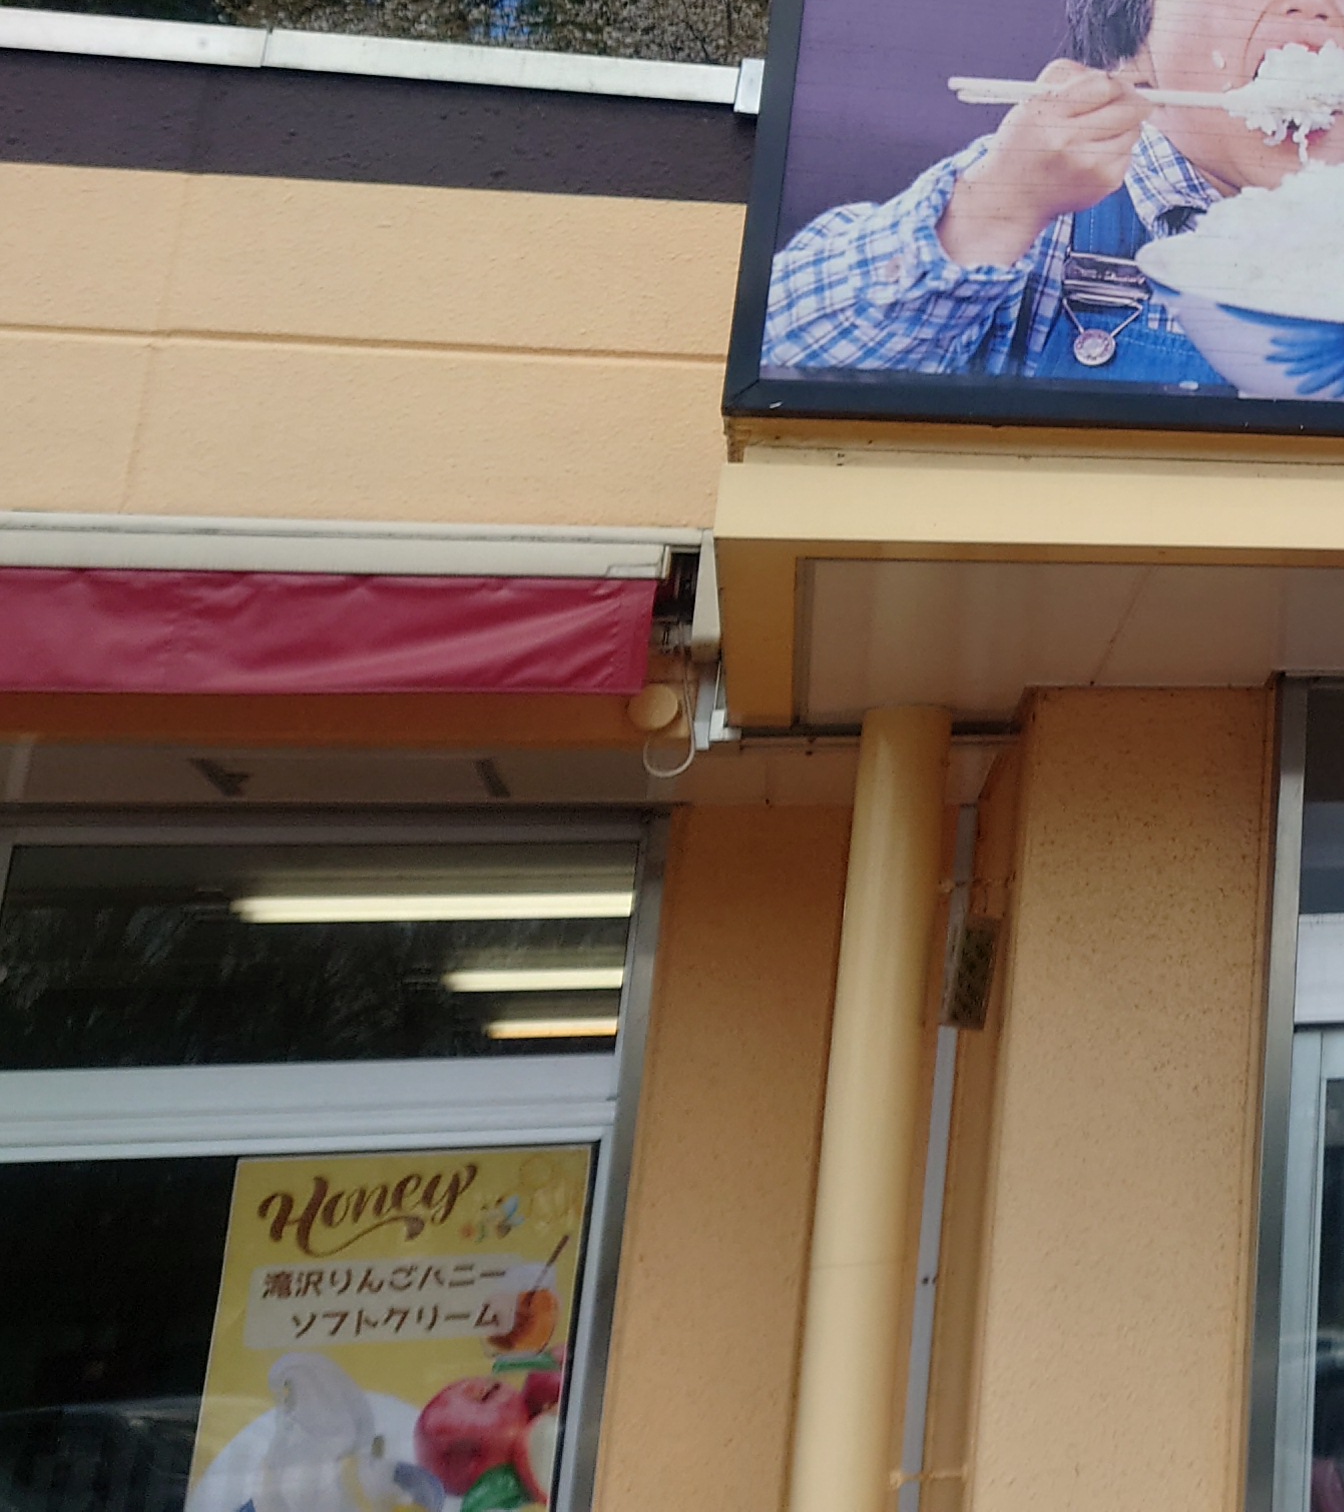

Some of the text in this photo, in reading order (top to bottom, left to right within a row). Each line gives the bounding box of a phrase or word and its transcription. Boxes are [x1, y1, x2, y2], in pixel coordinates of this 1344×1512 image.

[257, 1163, 479, 1258] Honey
[262, 1263, 507, 1299] 滝沢りんごハニー
[292, 1302, 501, 1338] ソフトクリーム
